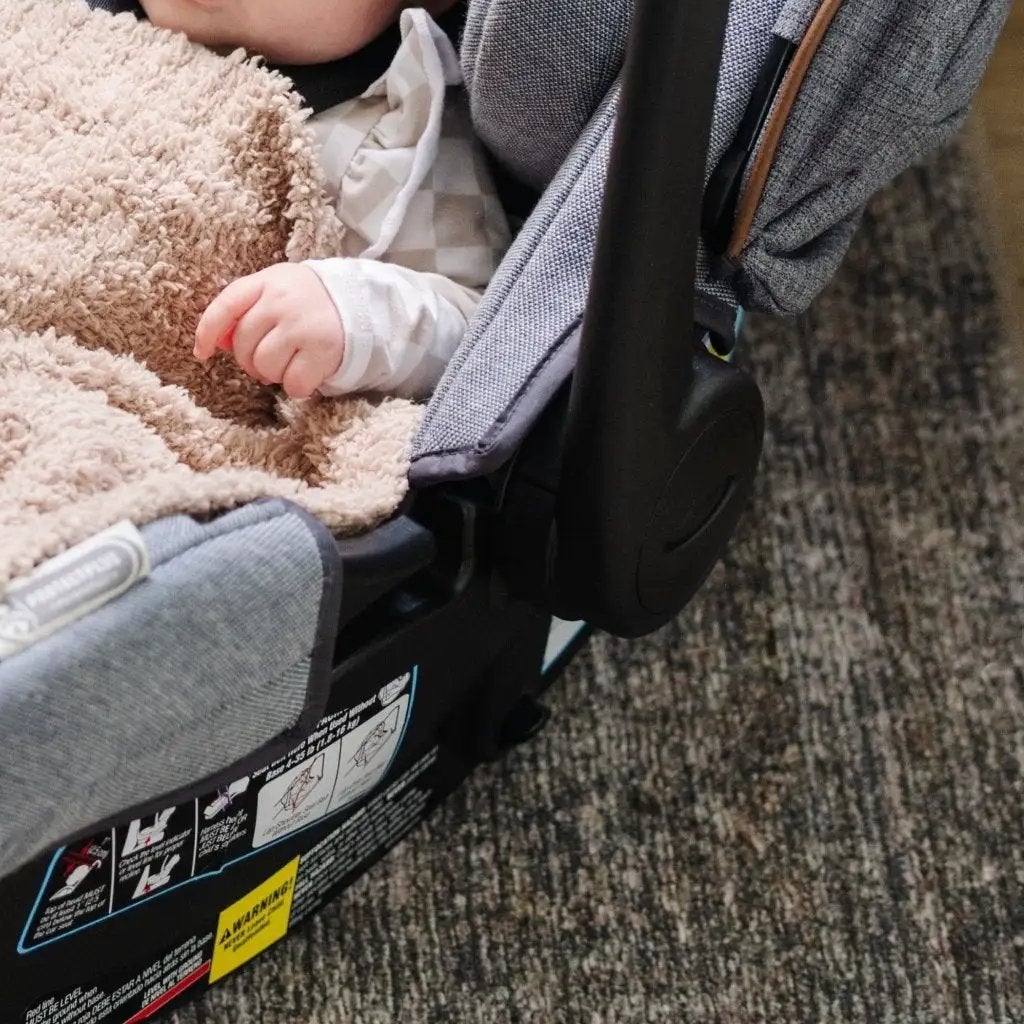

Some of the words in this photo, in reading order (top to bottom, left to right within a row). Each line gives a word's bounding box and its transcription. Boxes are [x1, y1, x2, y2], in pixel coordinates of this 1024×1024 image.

[307, 726, 327, 744] When
[329, 712, 347, 730] Used
[348, 694, 376, 718] Without
[265, 765, 285, 781] Base
[232, 877, 293, 931] WARNING!
[48, 1001, 58, 1015] BE
[60, 986, 82, 1006] LEVEL
[52, 1000, 77, 1024] ground
[78, 986, 97, 1003] when
[91, 995, 111, 1014] DEBE
[111, 979, 135, 1001] ESTAR
[135, 973, 142, 983] A
[142, 960, 162, 980] NIVEL
[143, 981, 161, 998] LEVEL
